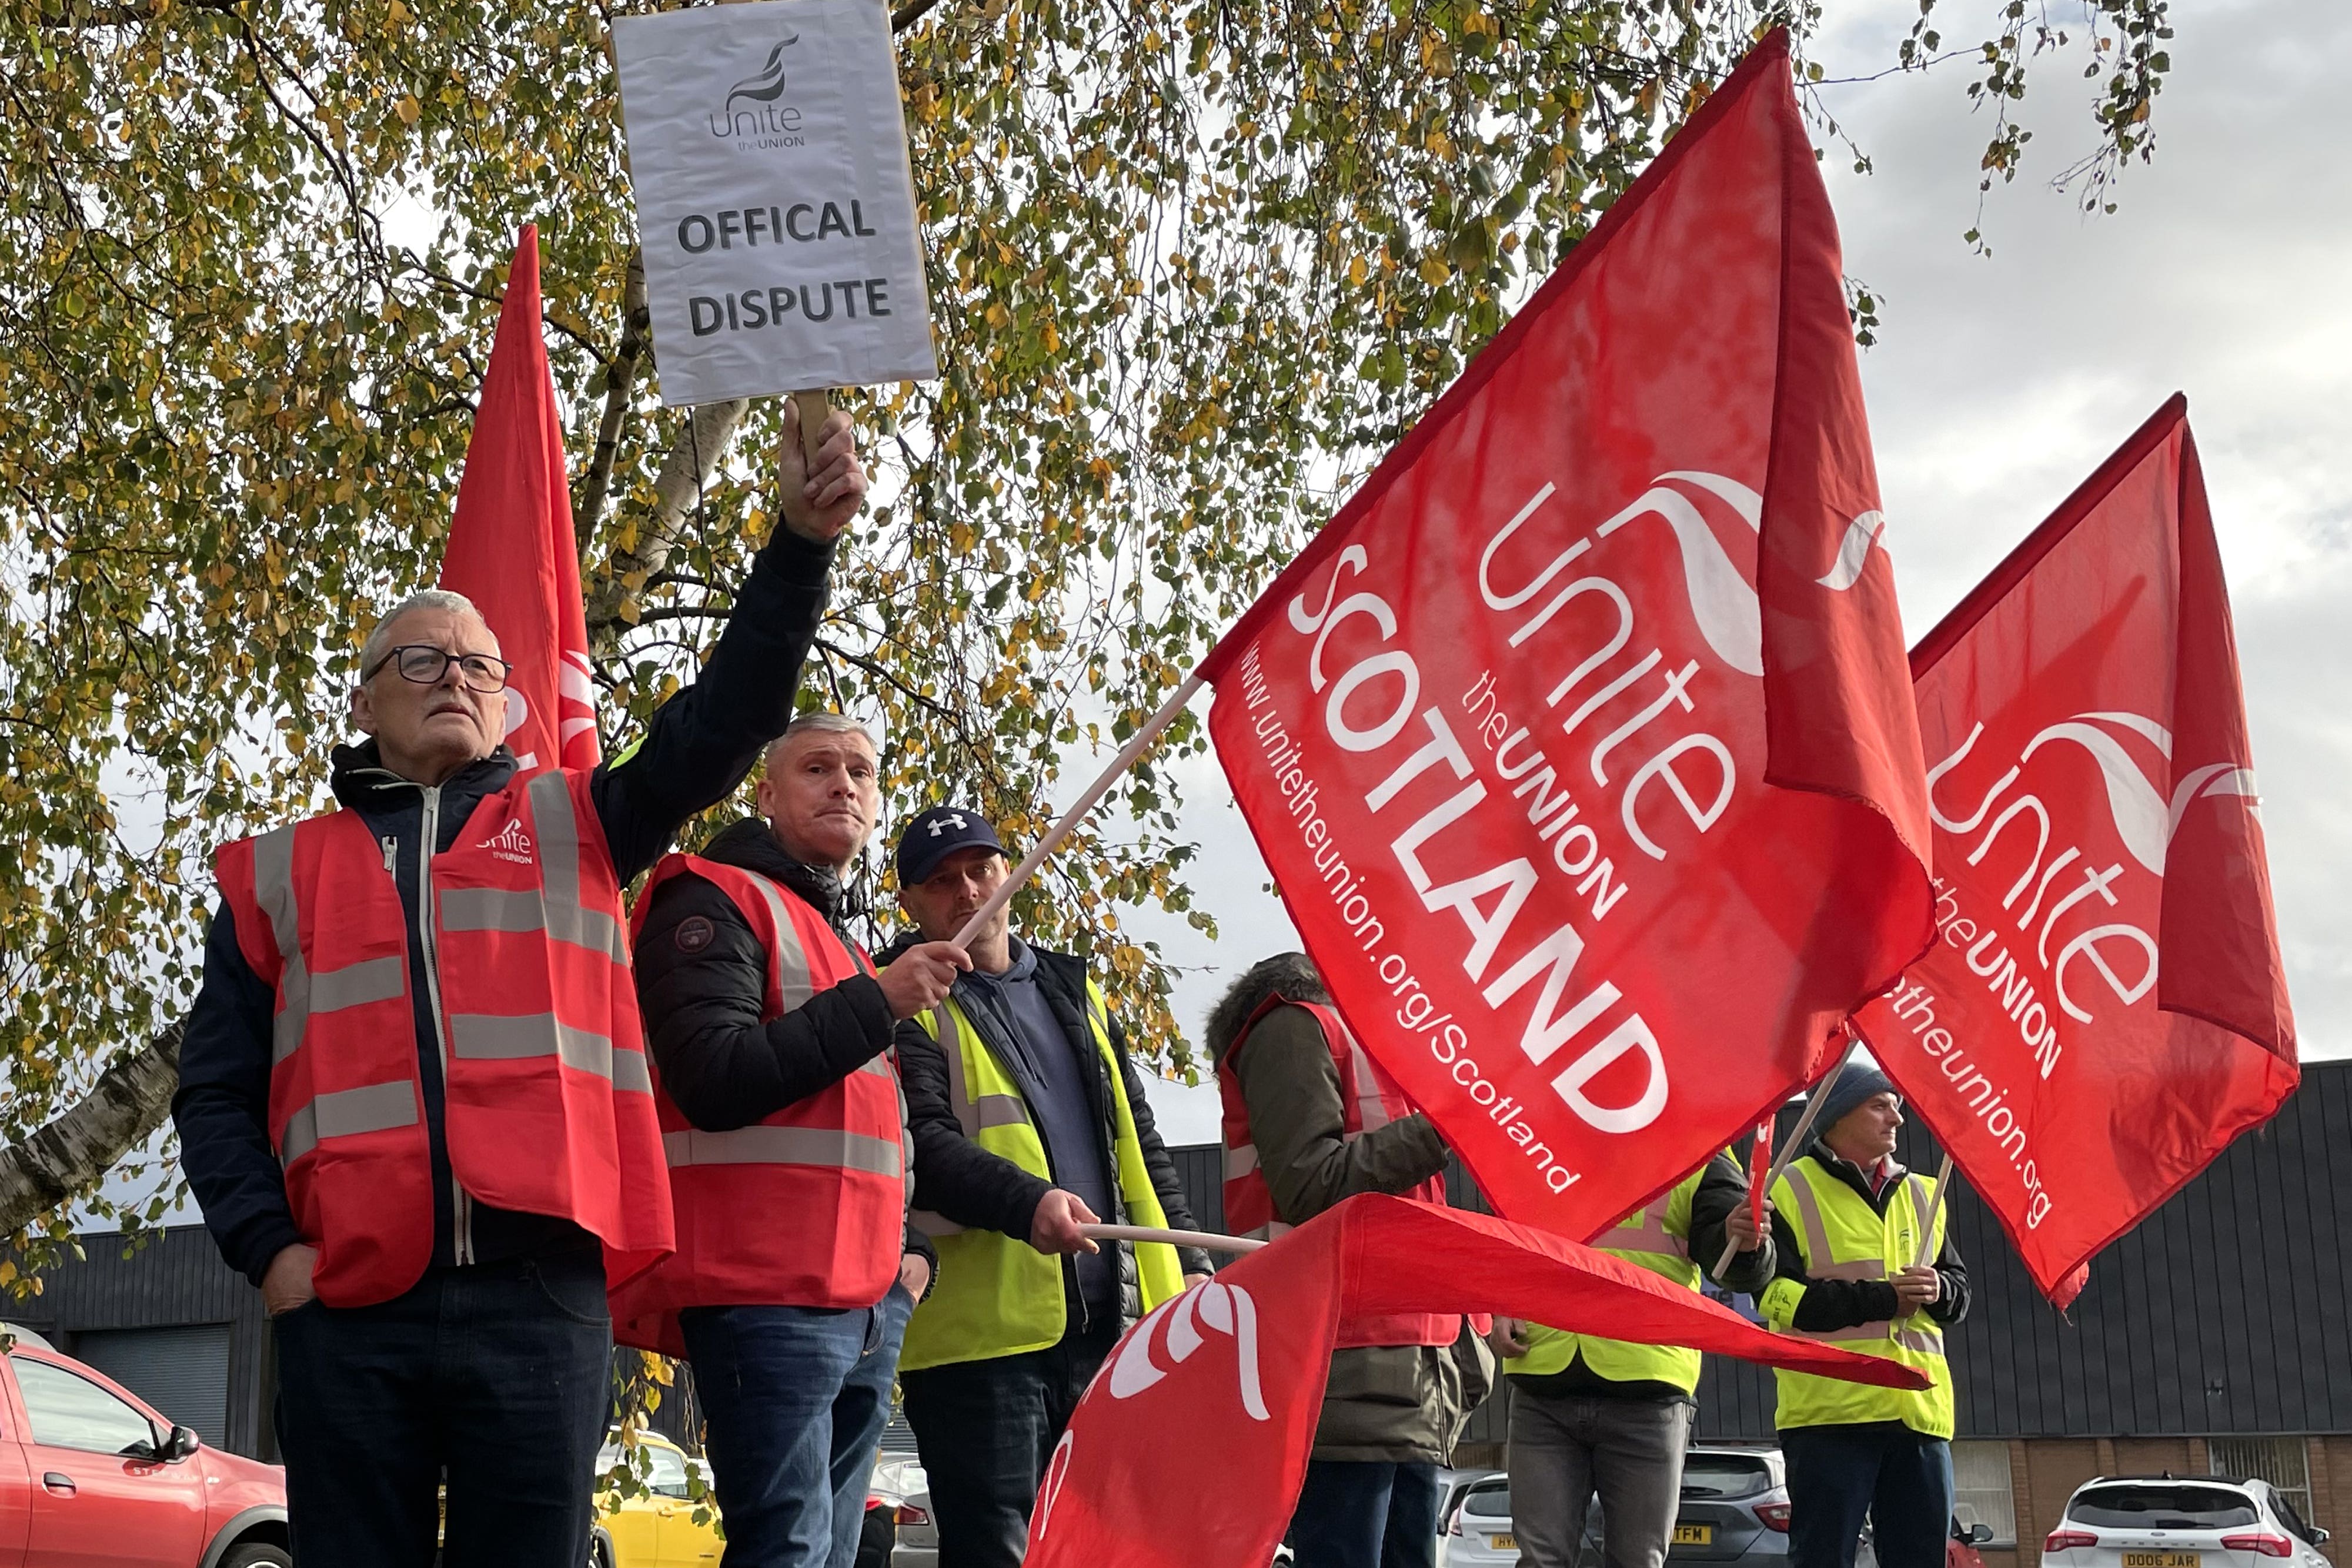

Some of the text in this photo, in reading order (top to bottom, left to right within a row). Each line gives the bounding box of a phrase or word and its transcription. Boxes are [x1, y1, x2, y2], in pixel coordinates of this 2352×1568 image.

[738, 136, 804, 151] theUNION
[677, 199, 877, 254] OFFICAL
[689, 278, 893, 337] DISPUTE
[1462, 669, 1629, 922] theUNION
[1287, 544, 1669, 1134] SCOTLAND
[1241, 640, 1582, 1195] www.unitetheunion.org/Scotland
[2168, 1554, 2194, 1568] JAR
